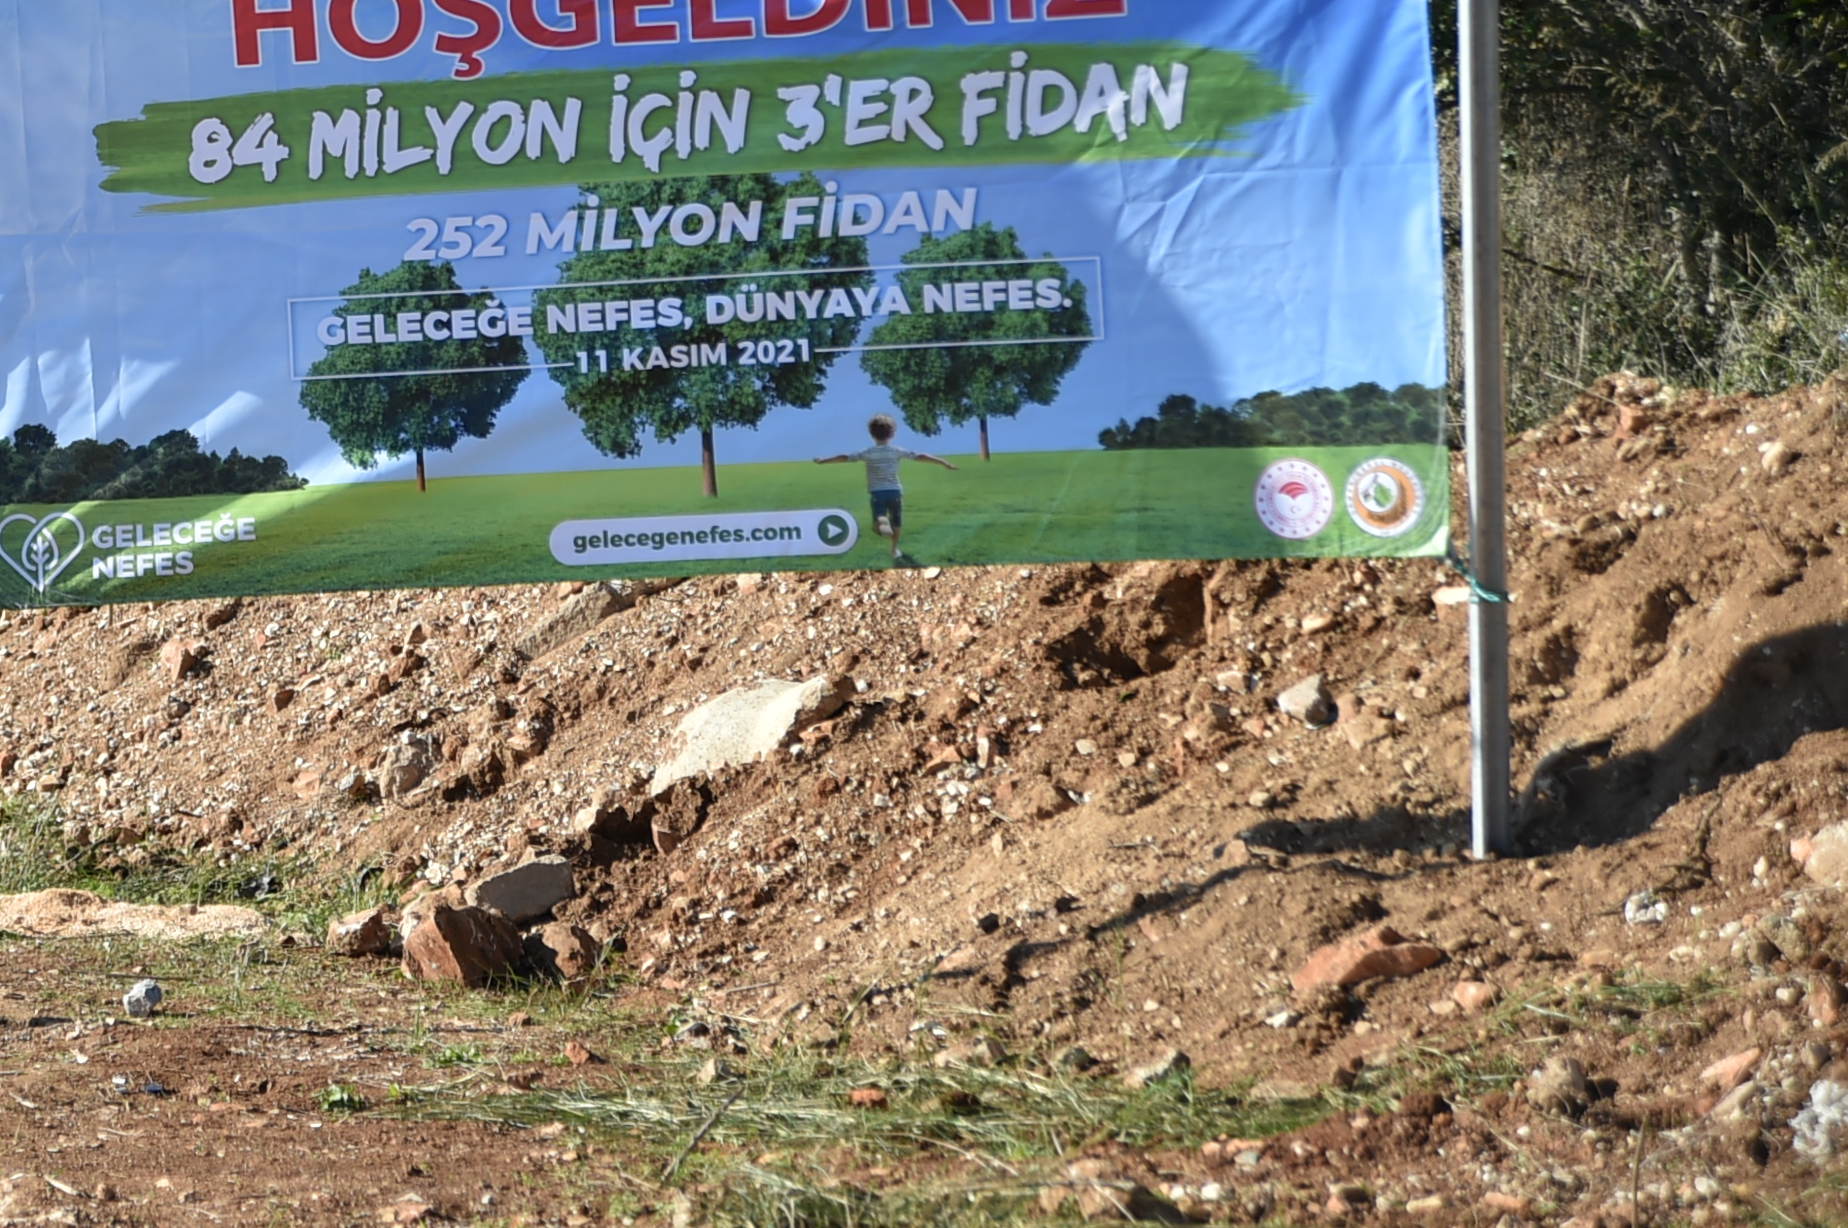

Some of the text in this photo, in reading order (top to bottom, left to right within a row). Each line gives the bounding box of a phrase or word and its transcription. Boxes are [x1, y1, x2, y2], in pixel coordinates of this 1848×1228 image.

[188, 50, 1189, 184] 84 MİLYON İÇİN 3'ER FİDAN
[403, 180, 979, 262] 252 MİLYON FİDAN
[316, 278, 1074, 346] GELECEĞE NEFES, DÜNYAYA NEFES.
[575, 338, 811, 374] 11 KASIM 2021
[91, 512, 257, 550] GELECEĞE
[572, 524, 803, 554] gelecegenefes.com
[91, 550, 195, 580] NEFES
